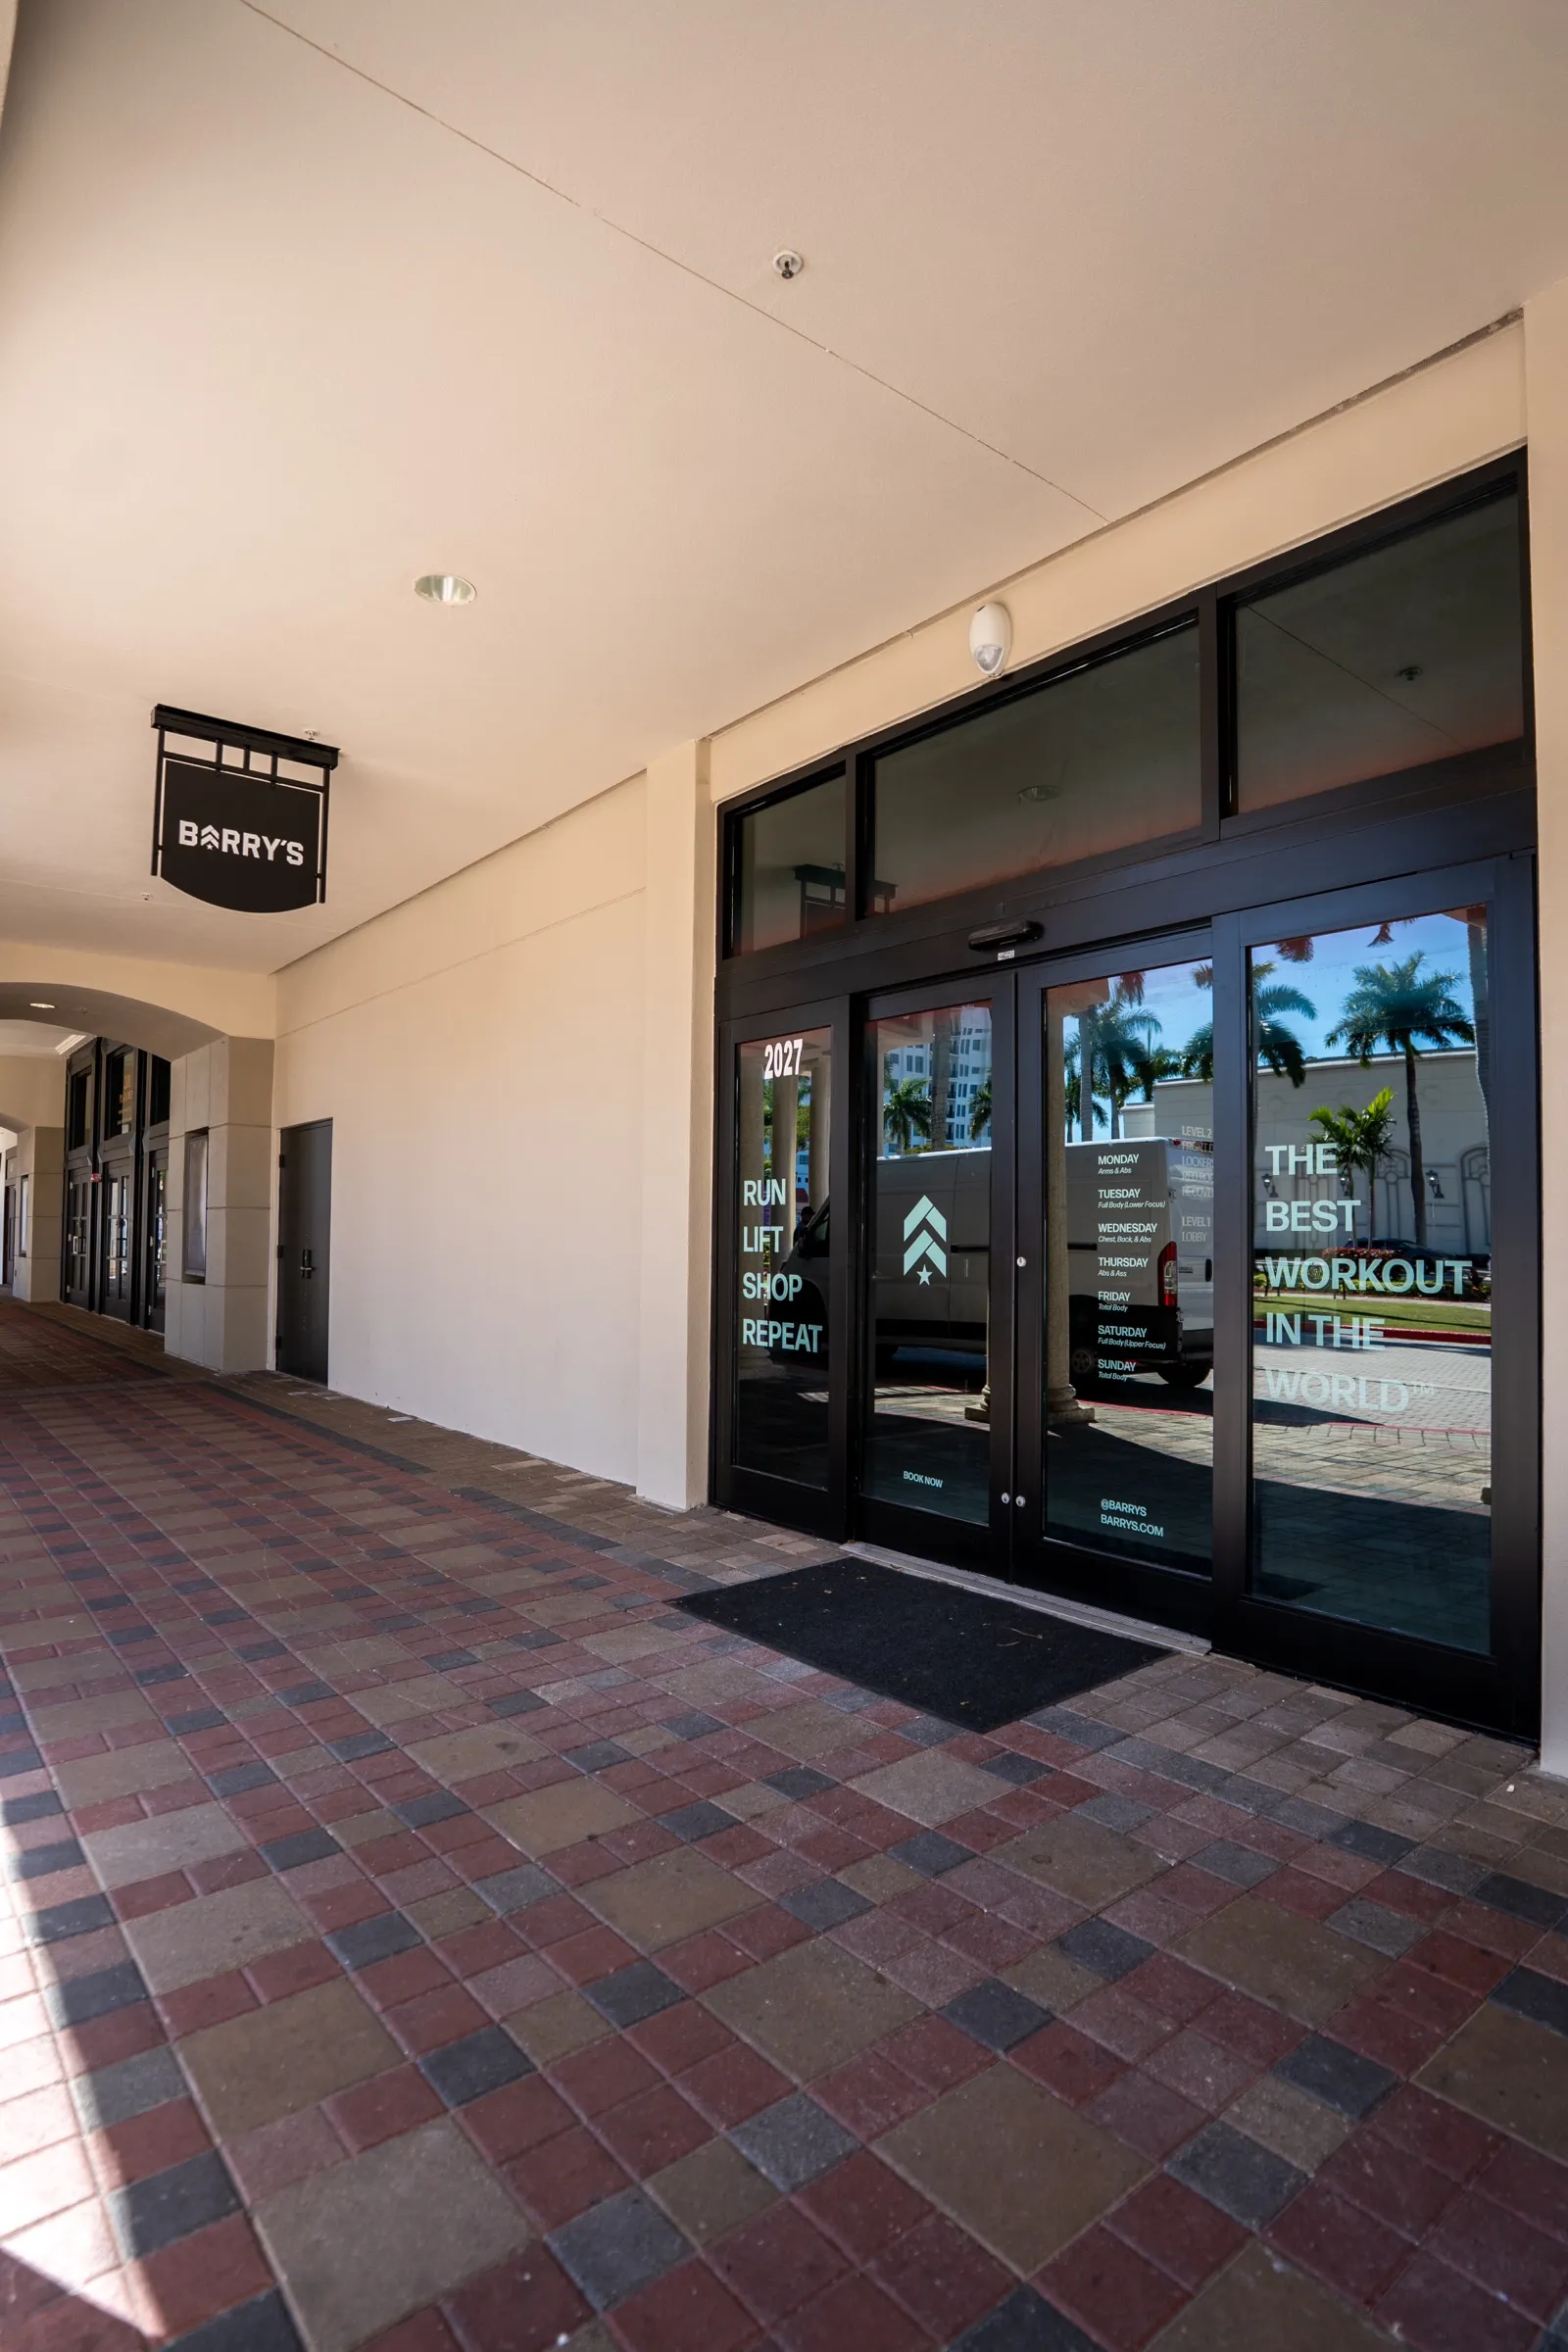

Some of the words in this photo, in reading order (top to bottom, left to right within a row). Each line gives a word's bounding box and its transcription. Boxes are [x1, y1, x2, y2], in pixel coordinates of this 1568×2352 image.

[178, 819, 304, 865] BARRY'S
[763, 1038, 804, 1080] 2027
[1182, 1126, 1205, 1138] LEVEL
[1206, 1129, 1212, 1139] 2
[1098, 1153, 1139, 1165] MONDAY
[1265, 1143, 1338, 1176] THE
[743, 1178, 786, 1206] RUN
[1098, 1189, 1141, 1199] TUESDAY
[1124, 1200, 1145, 1209] (Lower
[1182, 1216, 1205, 1227] LEVEL
[1206, 1217, 1211, 1227] 1
[1266, 1200, 1361, 1232] BEST
[1098, 1223, 1157, 1233] WEDNESDAY
[743, 1226, 784, 1253] LIFT
[1182, 1231, 1207, 1243] LOBBY
[1098, 1257, 1149, 1268] THURSDAY
[1265, 1256, 1473, 1295] WORKOUT
[742, 1272, 803, 1301] SHOP
[1098, 1292, 1131, 1302] FRIDAY
[1112, 1304, 1128, 1313] Body
[742, 1318, 823, 1353] REPEAT
[1098, 1325, 1148, 1338] SATURDAY
[1266, 1312, 1301, 1346] IN
[1308, 1315, 1386, 1350] THE
[1108, 1339, 1124, 1348] Body
[1124, 1340, 1145, 1348] (Upper
[1145, 1341, 1166, 1350] Focus)
[1098, 1359, 1136, 1372] SUNDAY
[1112, 1373, 1128, 1382] Body
[904, 1471, 924, 1484] BOOK
[924, 1476, 943, 1488] NOW
[1101, 1498, 1148, 1517] @BARRYS
[1101, 1514, 1164, 1537] BARRYS.COM
